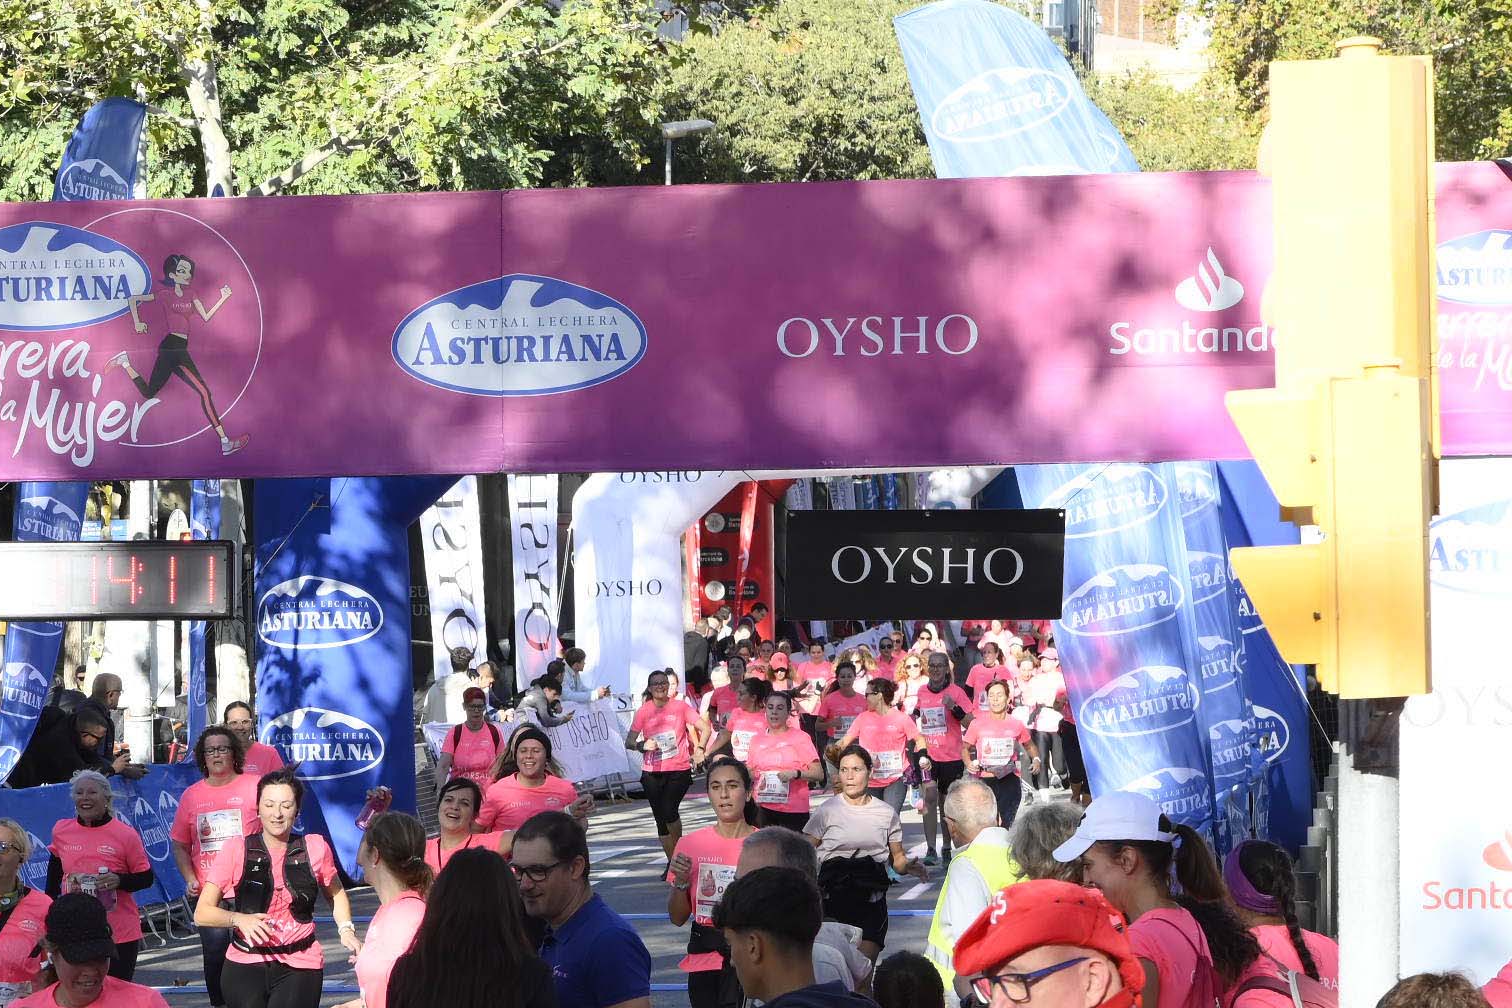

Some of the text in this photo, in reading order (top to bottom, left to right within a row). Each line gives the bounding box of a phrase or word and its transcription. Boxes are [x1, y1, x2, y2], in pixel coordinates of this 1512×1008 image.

[55, 259, 128, 273] LECHERA
[451, 315, 617, 330] CENTRAL LECHERA
[776, 314, 979, 358] OYSHO
[1109, 321, 1276, 355] Santand
[412, 322, 627, 366] ASTURIANA
[12, 374, 162, 468] Mujer
[831, 545, 1024, 586] OYSHO
[261, 606, 374, 632] ASTURIANA
